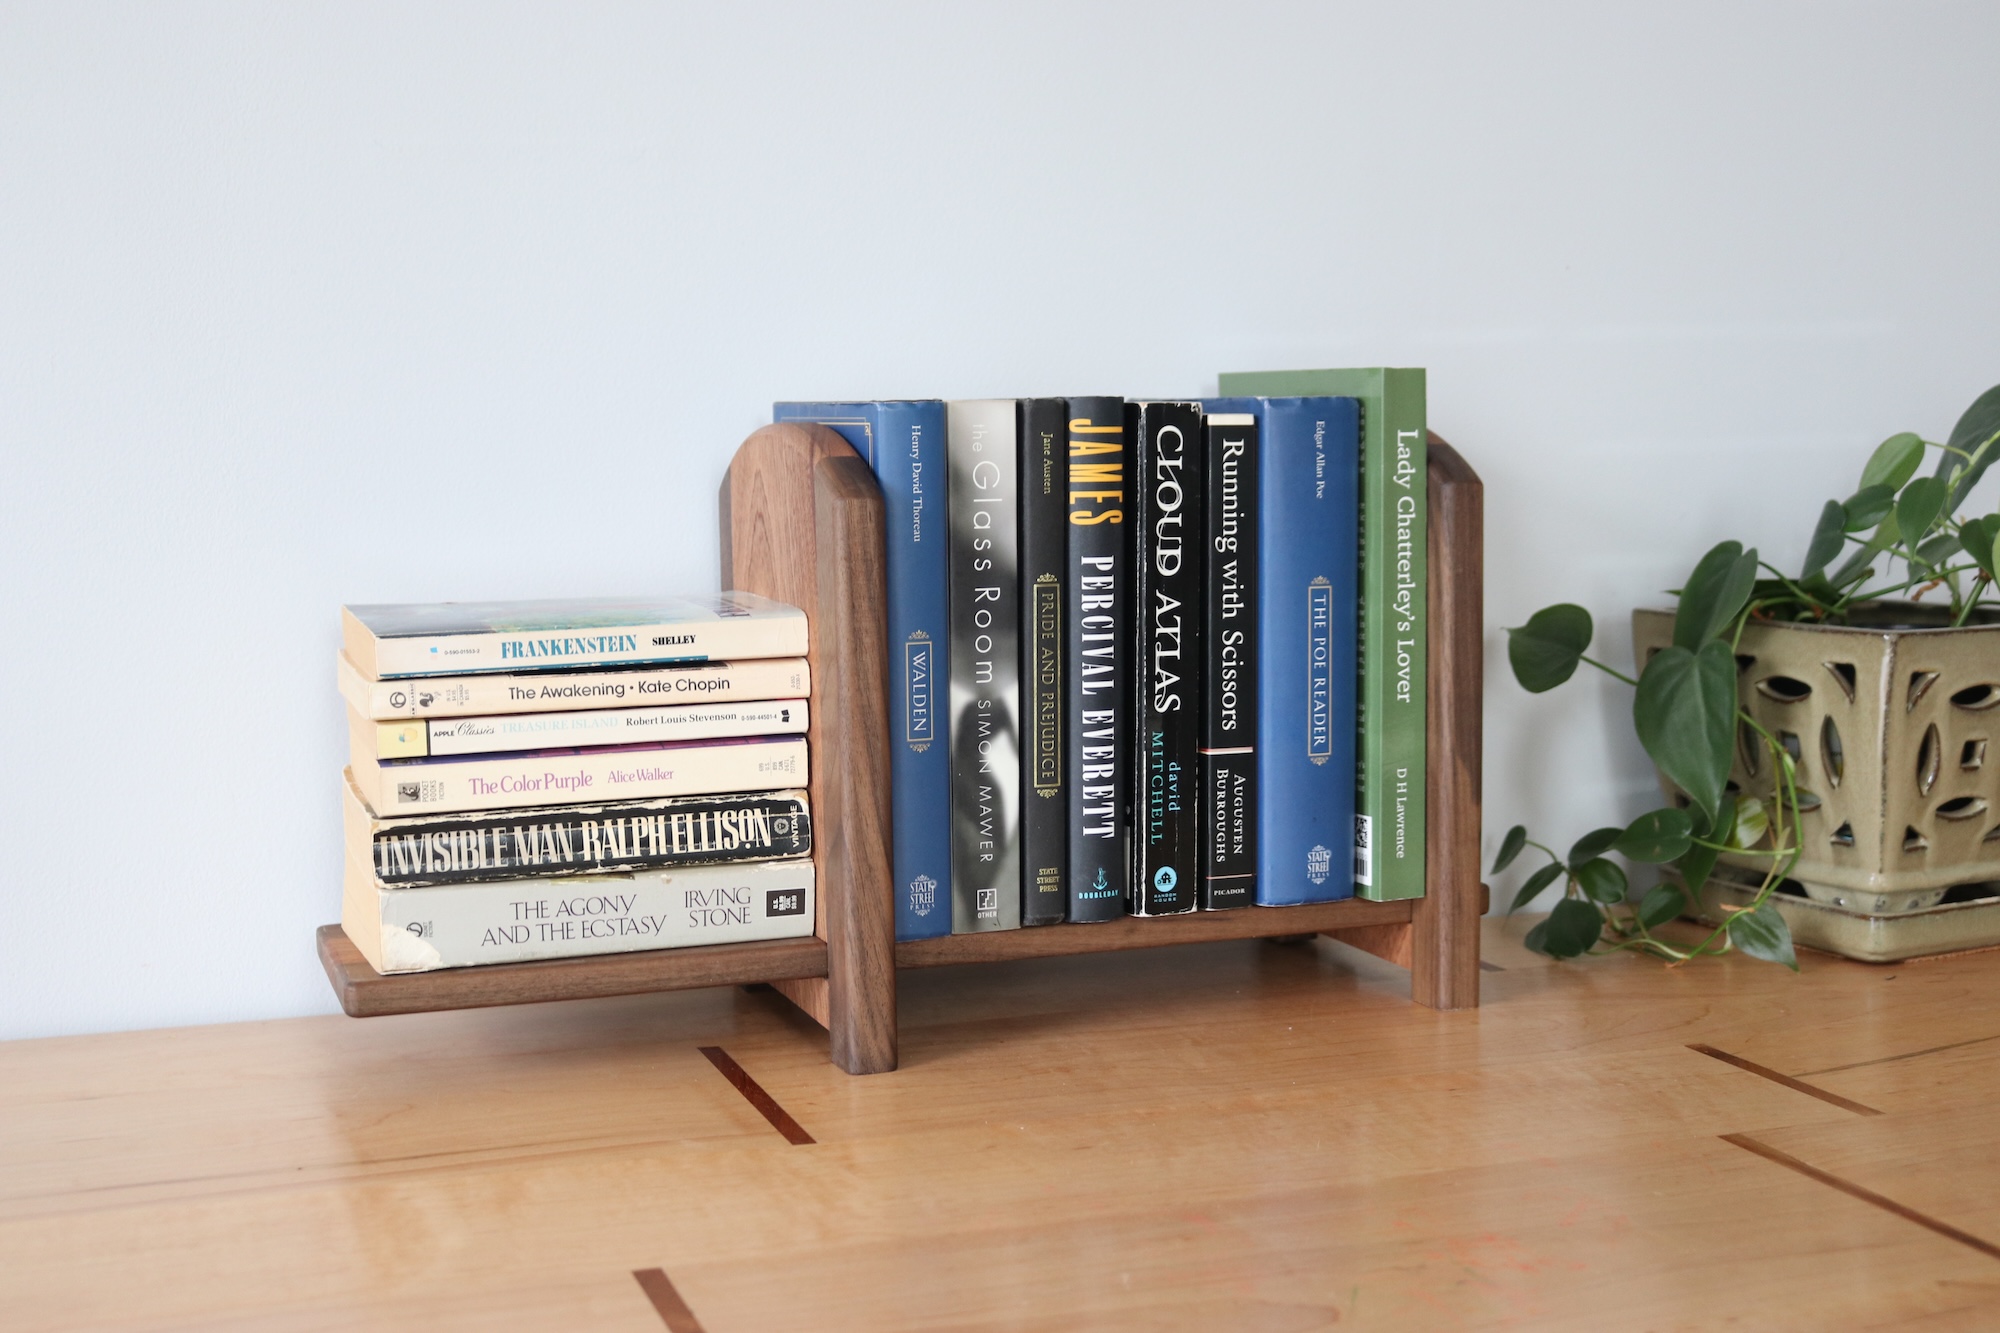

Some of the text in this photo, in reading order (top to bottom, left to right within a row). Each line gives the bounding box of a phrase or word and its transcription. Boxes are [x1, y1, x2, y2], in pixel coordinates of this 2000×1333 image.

[1040, 432, 1054, 495] Jane Austen
[1068, 418, 1124, 526] JAMES
[1313, 420, 1326, 499] Edgar Allan Poe
[909, 425, 923, 542] Henry David Thoreau
[972, 423, 1003, 684] the Glass Room
[1154, 425, 1184, 714] CLOUD ATLAS
[1392, 428, 1419, 704] Lady Chatterley's Lover
[1214, 438, 1245, 731] Running with Scissors
[501, 634, 637, 659] FRANKENSTEIN
[652, 634, 696, 646] SHELLEY
[509, 677, 730, 700] The Awakening Kate Chopin
[912, 651, 927, 731] WALDEN
[1040, 593, 1055, 779] PRIDE AND PREJUDICE
[1313, 594, 1327, 746] THE POE READER
[1081, 555, 1115, 839] PERCIVAL EVERETT
[433, 729, 455, 738] APPLE
[455, 722, 495, 737] Classics
[502, 719, 569, 734] TREASURE
[571, 717, 618, 730] ISLAND
[626, 715, 659, 727] Robert
[660, 713, 687, 725] Louis
[689, 712, 737, 723] Stevenson
[421, 780, 429, 803] POCKET
[469, 767, 674, 796] The Color Purple Alice Walker
[977, 700, 993, 862] SIMON MAWER
[1151, 731, 1164, 845] MITCHELL
[1168, 761, 1181, 812] david
[790, 804, 799, 848] VINTAGE
[1215, 768, 1230, 863] BURROUGHS
[1233, 773, 1247, 855] AUGUSTEN
[1395, 768, 1408, 859] D H Lawrence
[378, 807, 772, 877] INVISIBLE MAN RALPH ELLISON
[1307, 851, 1328, 864] STATE
[909, 881, 933, 893] STATE
[1036, 875, 1060, 885] STREET
[1038, 867, 1059, 876] STATE
[1039, 884, 1058, 893] PRESS
[1307, 862, 1330, 873] STREET
[509, 894, 638, 920] THE AGONY
[684, 887, 751, 908] IRVING
[909, 892, 935, 905] STREET
[1078, 889, 1119, 900] DOUBLEDAY
[1213, 888, 1246, 896] PICADOR
[481, 914, 667, 947] AND THE ECSTASY
[689, 907, 752, 928] STONE
[977, 911, 997, 919] OTHER
